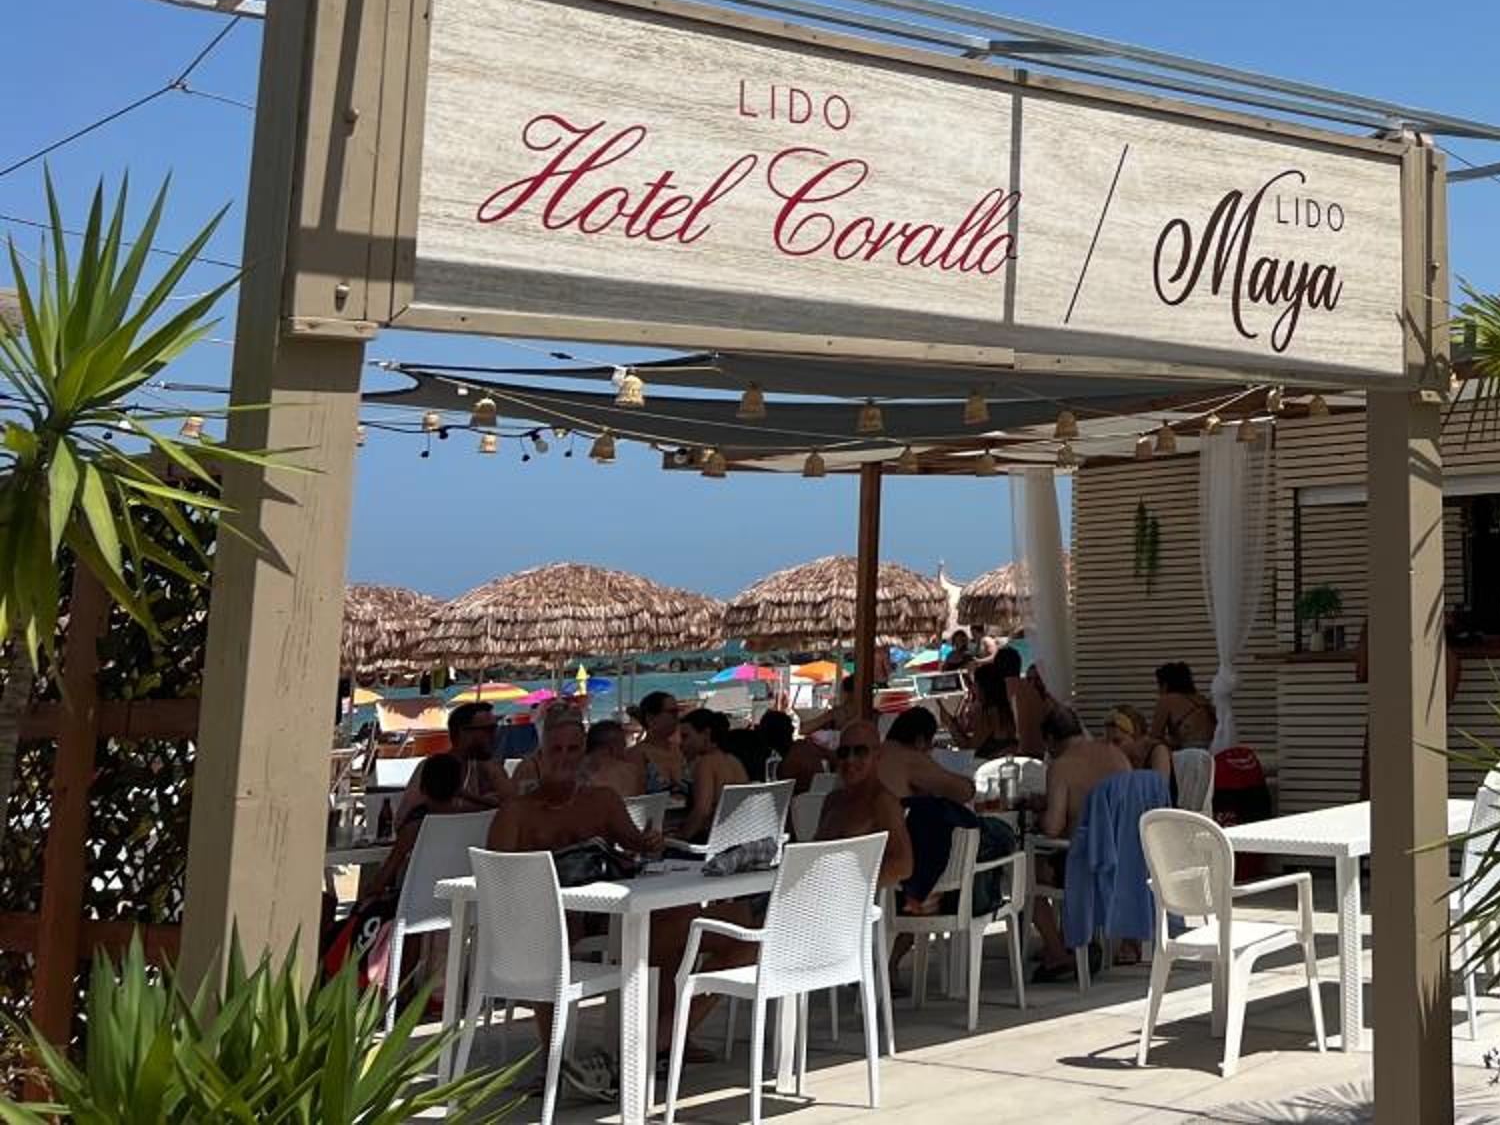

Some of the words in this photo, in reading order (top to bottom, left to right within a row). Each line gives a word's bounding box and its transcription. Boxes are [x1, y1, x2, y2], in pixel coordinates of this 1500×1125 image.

[739, 79, 851, 130] LIDO
[477, 113, 758, 244] Hotel
[766, 146, 1021, 274] Corallo
[1276, 194, 1344, 232] LIDO
[1153, 169, 1343, 353] Maya
